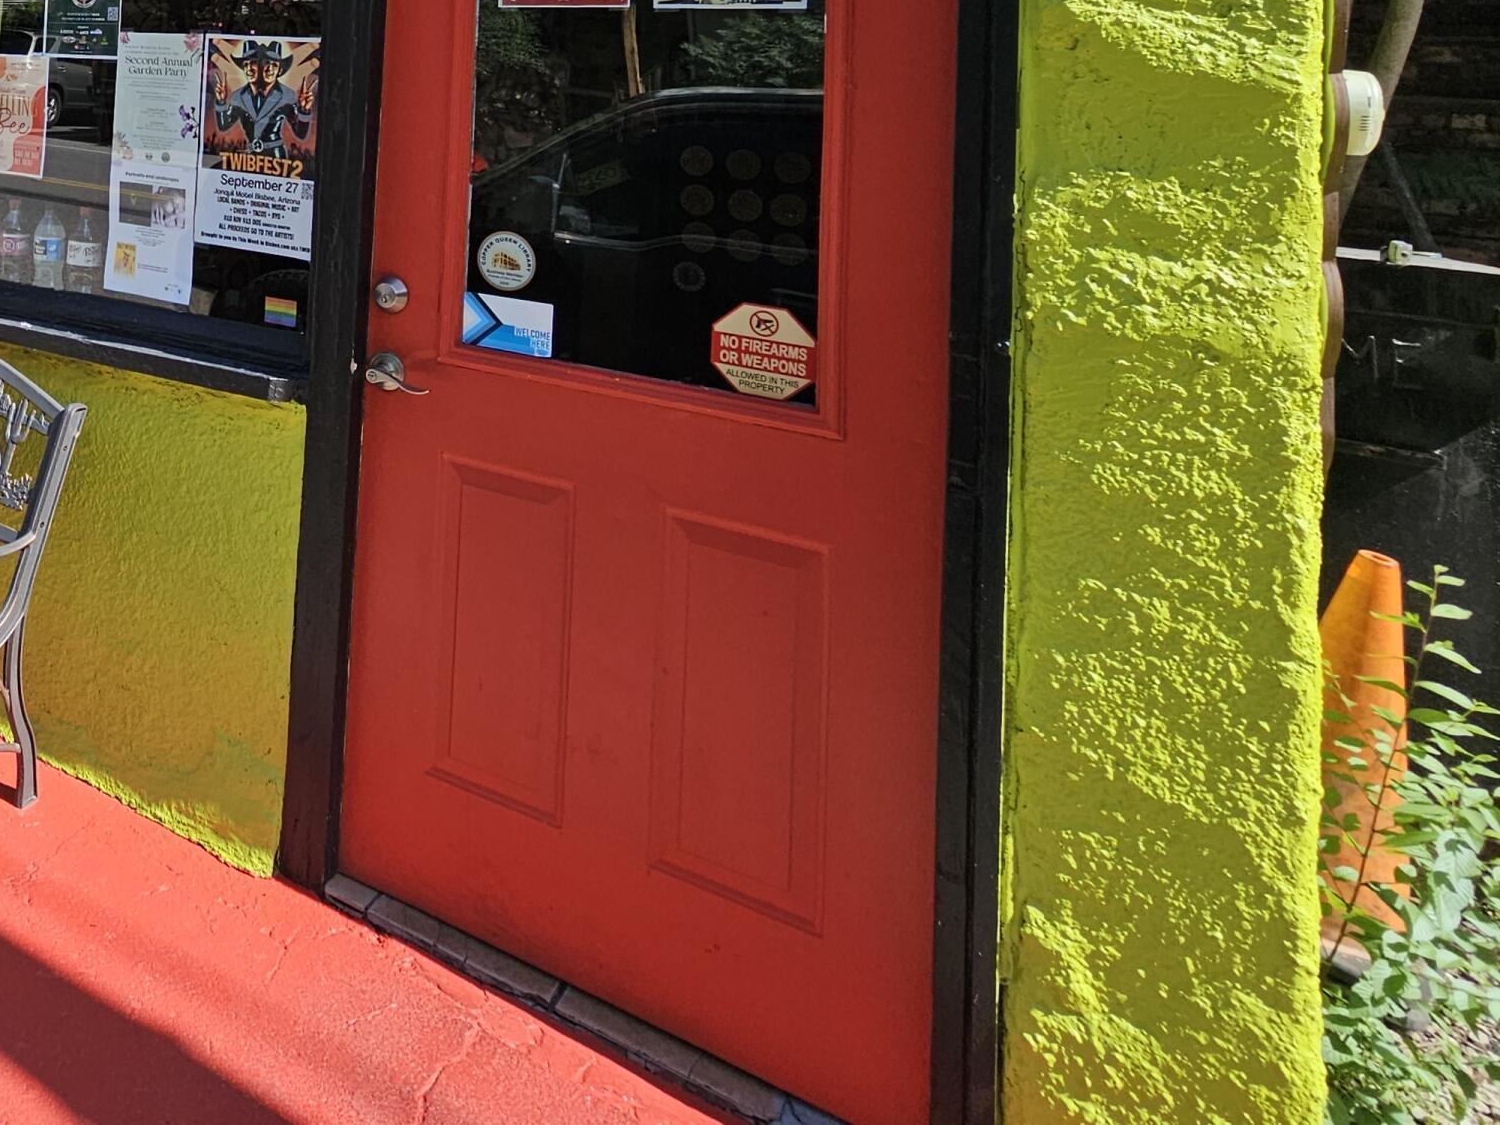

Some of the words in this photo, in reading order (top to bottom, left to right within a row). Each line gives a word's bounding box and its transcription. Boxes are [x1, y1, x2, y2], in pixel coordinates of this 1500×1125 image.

[125, 56, 159, 66] Second
[162, 57, 193, 67] Annual
[128, 65, 162, 76] Garden
[220, 173, 283, 192] September
[285, 181, 299, 194] 27
[277, 196, 301, 206] Arizona
[514, 326, 550, 338] WELCOME
[531, 338, 550, 350] HERE
[720, 334, 739, 348] NO
[741, 337, 808, 361] FIREARMS
[719, 350, 739, 364] OR
[741, 353, 807, 377] WEAPONS
[726, 368, 767, 383] ALLOWED
[769, 376, 778, 385] IN
[779, 378, 799, 388] THIS
[739, 379, 786, 395] PROPERTY
